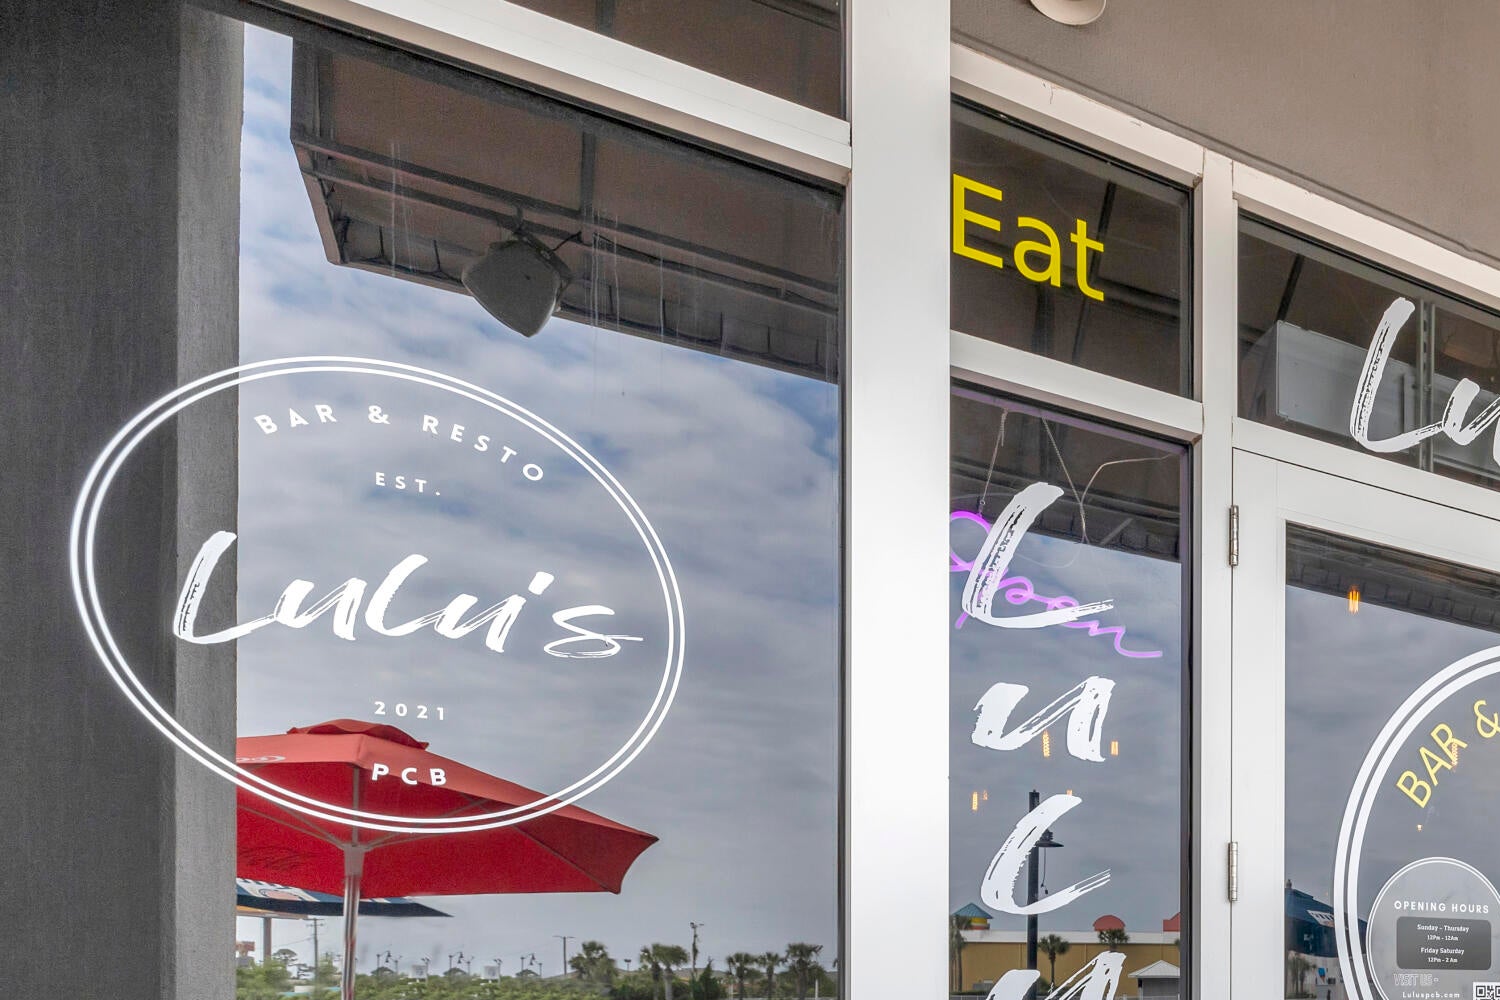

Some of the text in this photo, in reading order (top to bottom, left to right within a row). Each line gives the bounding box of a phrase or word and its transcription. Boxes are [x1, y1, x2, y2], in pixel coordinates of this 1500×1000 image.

[952, 173, 1104, 301] Eat
[253, 404, 543, 481] BAR & RESTO
[375, 471, 440, 496] EST.
[373, 701, 446, 721] 2021
[371, 763, 447, 786] PCB
[1396, 723, 1468, 808] BAR
[1394, 900, 1489, 914] OPENING HOURS
[1417, 924, 1439, 932] Sunday
[1443, 925, 1469, 933] Thursday
[1393, 973, 1419, 986] VISIT
[1420, 973, 1432, 986] US
